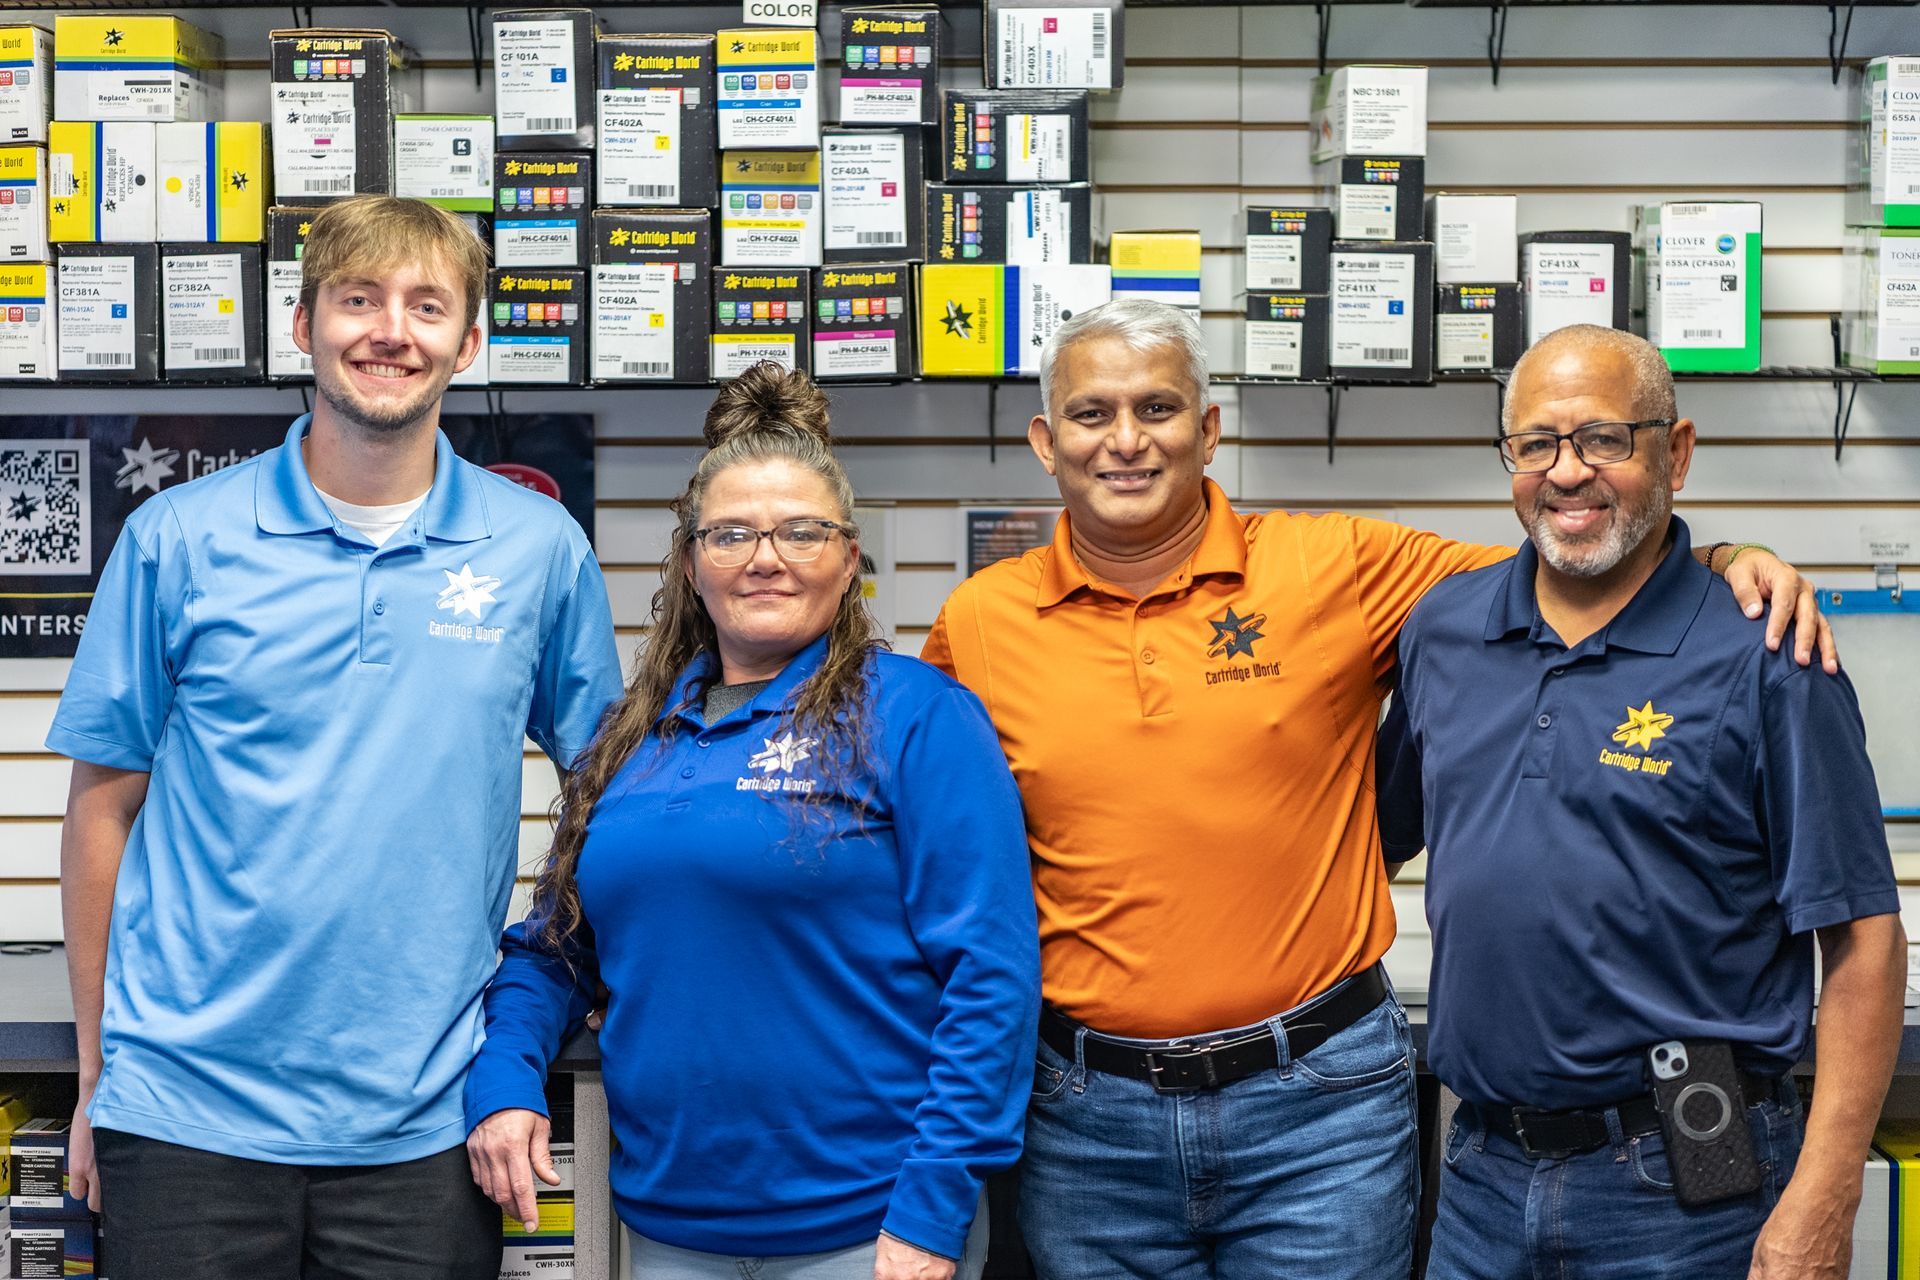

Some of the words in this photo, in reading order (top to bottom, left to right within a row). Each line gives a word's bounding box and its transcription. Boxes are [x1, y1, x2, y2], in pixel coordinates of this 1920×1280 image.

[751, 4, 812, 17] COLOR
[870, 21, 903, 34] Cartridge
[313, 40, 342, 52] Cartridge
[344, 40, 362, 50] World
[748, 42, 778, 53] Cartridge
[780, 42, 800, 51] World
[636, 56, 674, 71] Cartridge
[676, 56, 700, 69] World
[1028, 45, 1036, 84] CF403X
[613, 95, 632, 103] Cartridge
[954, 102, 966, 122] World
[1892, 114, 1916, 122] 655A
[302, 113, 332, 125] Cartridge
[333, 113, 351, 124] World
[604, 119, 643, 127] CF402A
[746, 115, 794, 123] CH-C-CF401A
[954, 124, 967, 153] Cartridge
[458, 142, 466, 150] K
[106, 147, 116, 166] World
[120, 157, 126, 166] HP
[523, 162, 556, 176] Cartridge
[557, 162, 578, 174] World
[754, 162, 784, 173] Cartridge
[832, 167, 870, 175] CF403A
[106, 168, 118, 196] Cartridge
[942, 193, 953, 212] World
[942, 214, 955, 243] Cartridge
[521, 234, 568, 242] PH-C-CF401A
[632, 231, 670, 247] Cartridge
[671, 232, 696, 245] World
[749, 235, 798, 243] CH-Y-CF402A
[70, 265, 89, 274] Cartridge
[1539, 260, 1580, 268] CF413X
[1692, 259, 1735, 268] (CF450A)
[14, 276, 33, 286] World
[608, 273, 626, 281] Cartridge
[742, 276, 775, 290] Cartridge
[776, 276, 798, 288] World
[841, 273, 874, 286] Cartridge
[875, 272, 896, 285] World
[169, 284, 211, 292] CF382A
[518, 278, 550, 292] Cartridge
[551, 278, 572, 290] World
[1338, 284, 1376, 292] CF411X
[1722, 282, 1730, 291] K
[1887, 283, 1917, 291] CF452A
[62, 288, 100, 296] CF381A
[1033, 283, 1042, 302] World
[599, 296, 637, 305] CF402A
[978, 298, 986, 314] World
[1033, 304, 1044, 332] Cartridge
[978, 317, 987, 343] Cartridge
[429, 620, 472, 640] Cartridge
[476, 626, 504, 642] World
[1206, 666, 1250, 685] Cartridge
[1253, 662, 1280, 678] World
[1599, 748, 1640, 771] Cartridge
[1641, 756, 1670, 776] World
[736, 777, 781, 792] Cartridge
[782, 778, 812, 792] World
